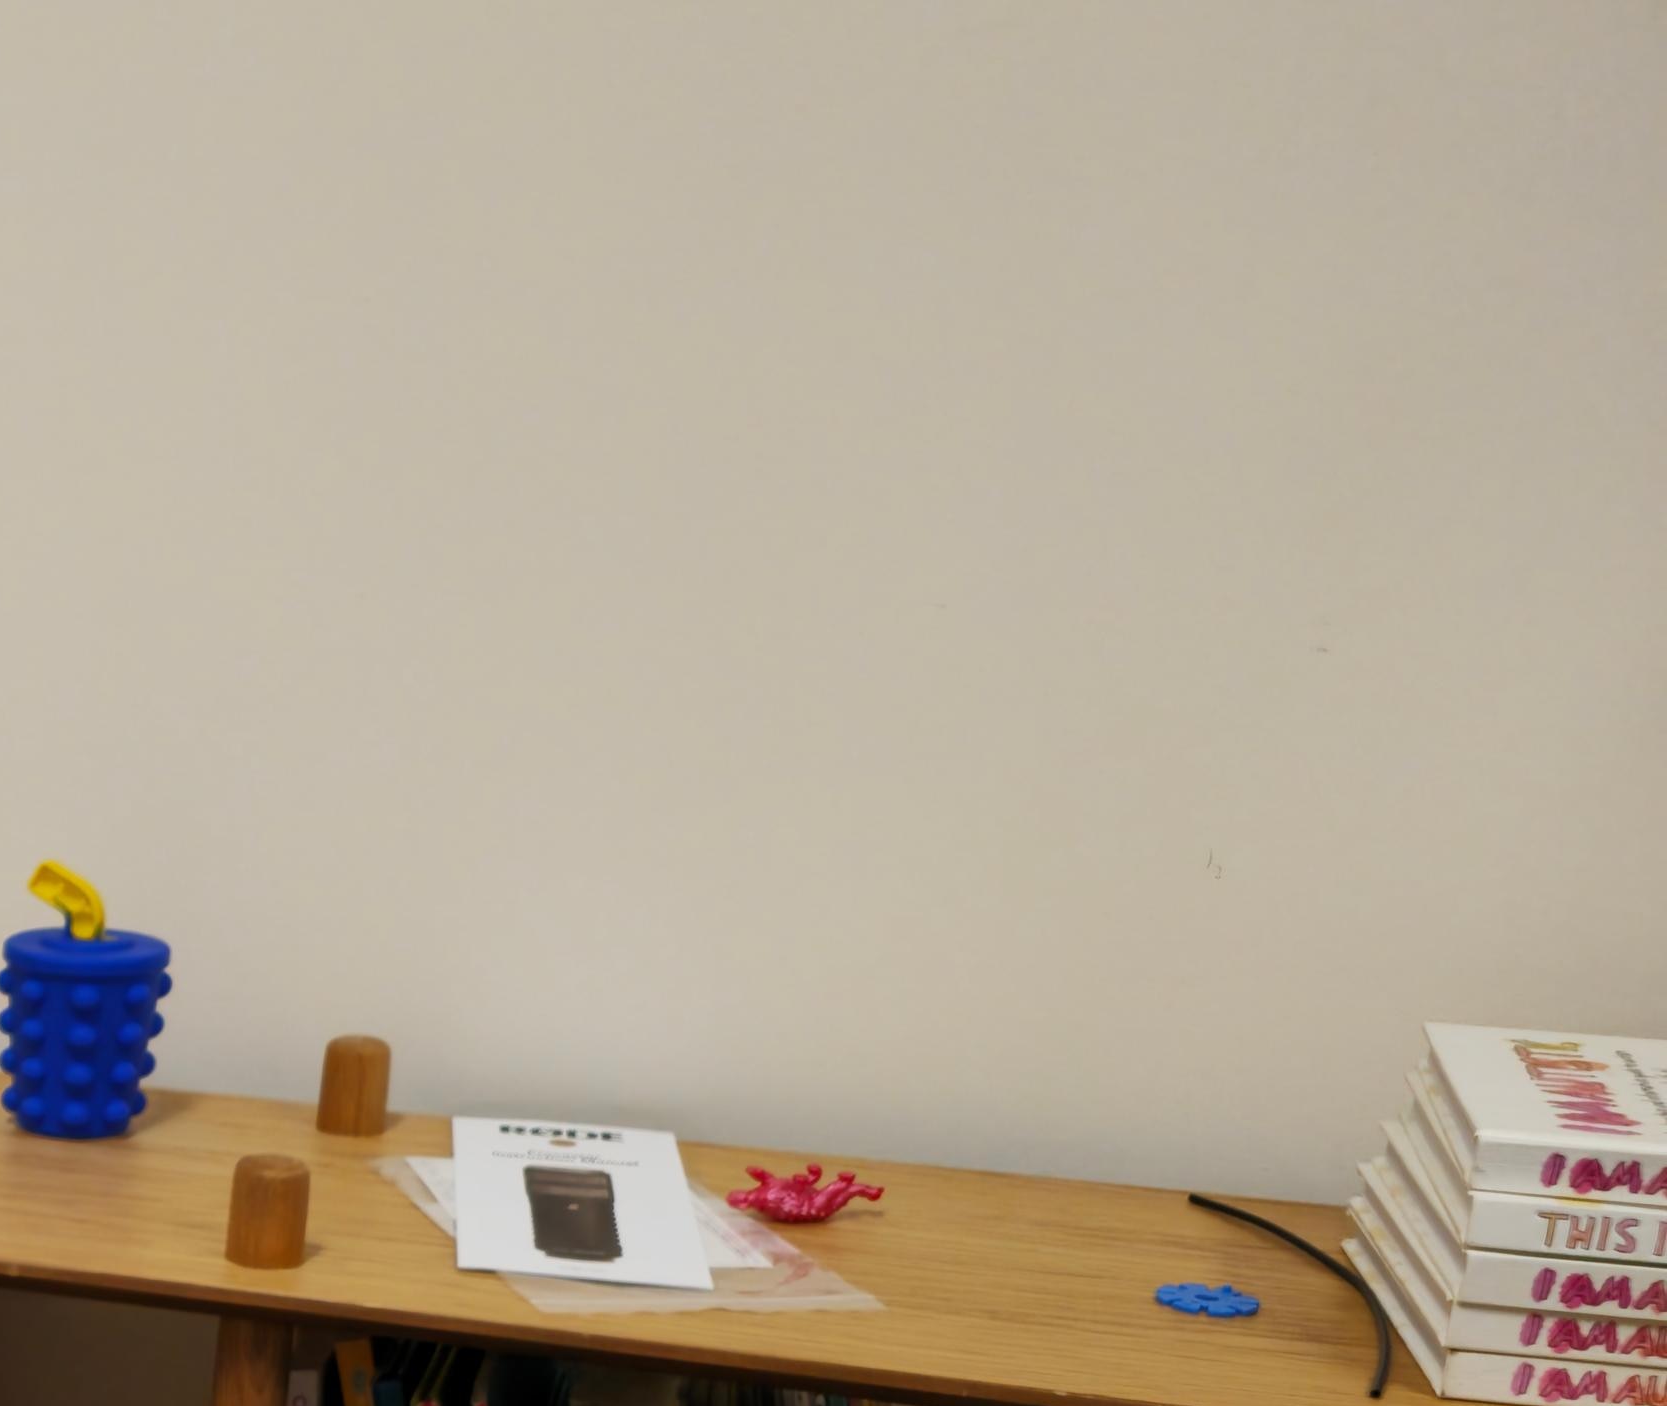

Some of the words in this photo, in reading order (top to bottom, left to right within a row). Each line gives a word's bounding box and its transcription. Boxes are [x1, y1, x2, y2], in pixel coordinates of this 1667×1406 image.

[1540, 1152, 1566, 1187] I
[1569, 1157, 1642, 1194] AM
[1538, 1211, 1639, 1254] THIS
[1531, 1267, 1557, 1303] I
[1559, 1272, 1632, 1310] AM
[1519, 1313, 1544, 1346] I
[1547, 1317, 1618, 1353] AM
[1511, 1361, 1535, 1396] I
[1538, 1367, 1609, 1403] AM
